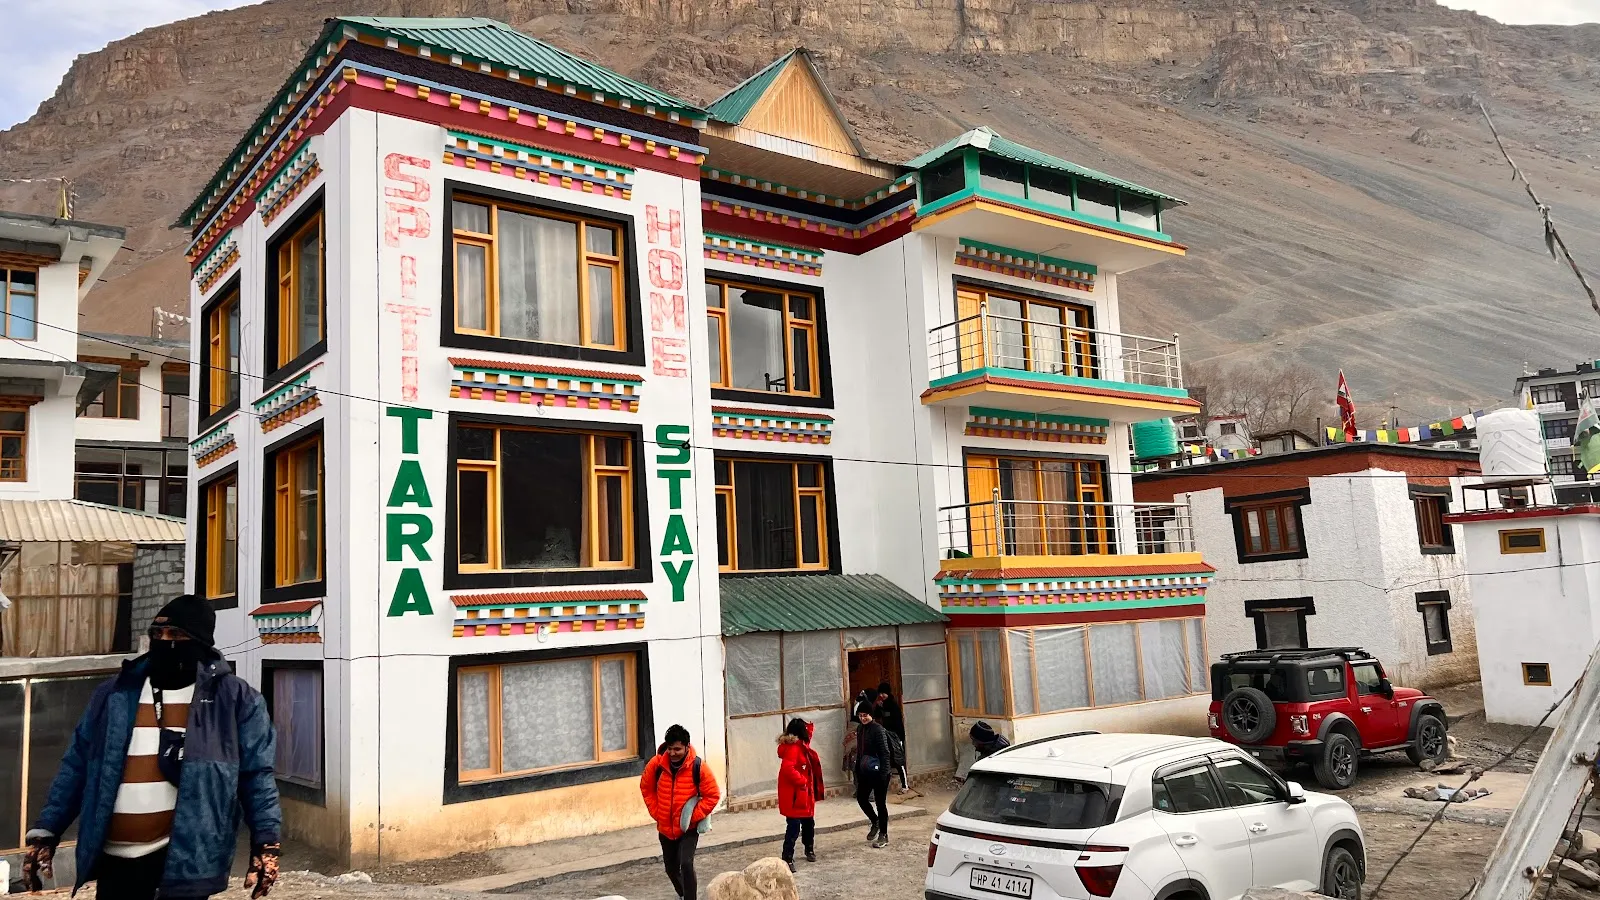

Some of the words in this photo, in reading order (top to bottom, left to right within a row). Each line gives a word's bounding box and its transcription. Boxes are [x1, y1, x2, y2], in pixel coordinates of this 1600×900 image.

[384, 152, 432, 402] SPITI
[645, 204, 688, 378] HOME
[386, 406, 435, 617] TARA
[655, 424, 694, 602] STAY
[963, 854, 1033, 870] CRETA
[977, 873, 988, 886] HP
[991, 876, 1001, 889] 41
[1005, 879, 1028, 894] 4114
